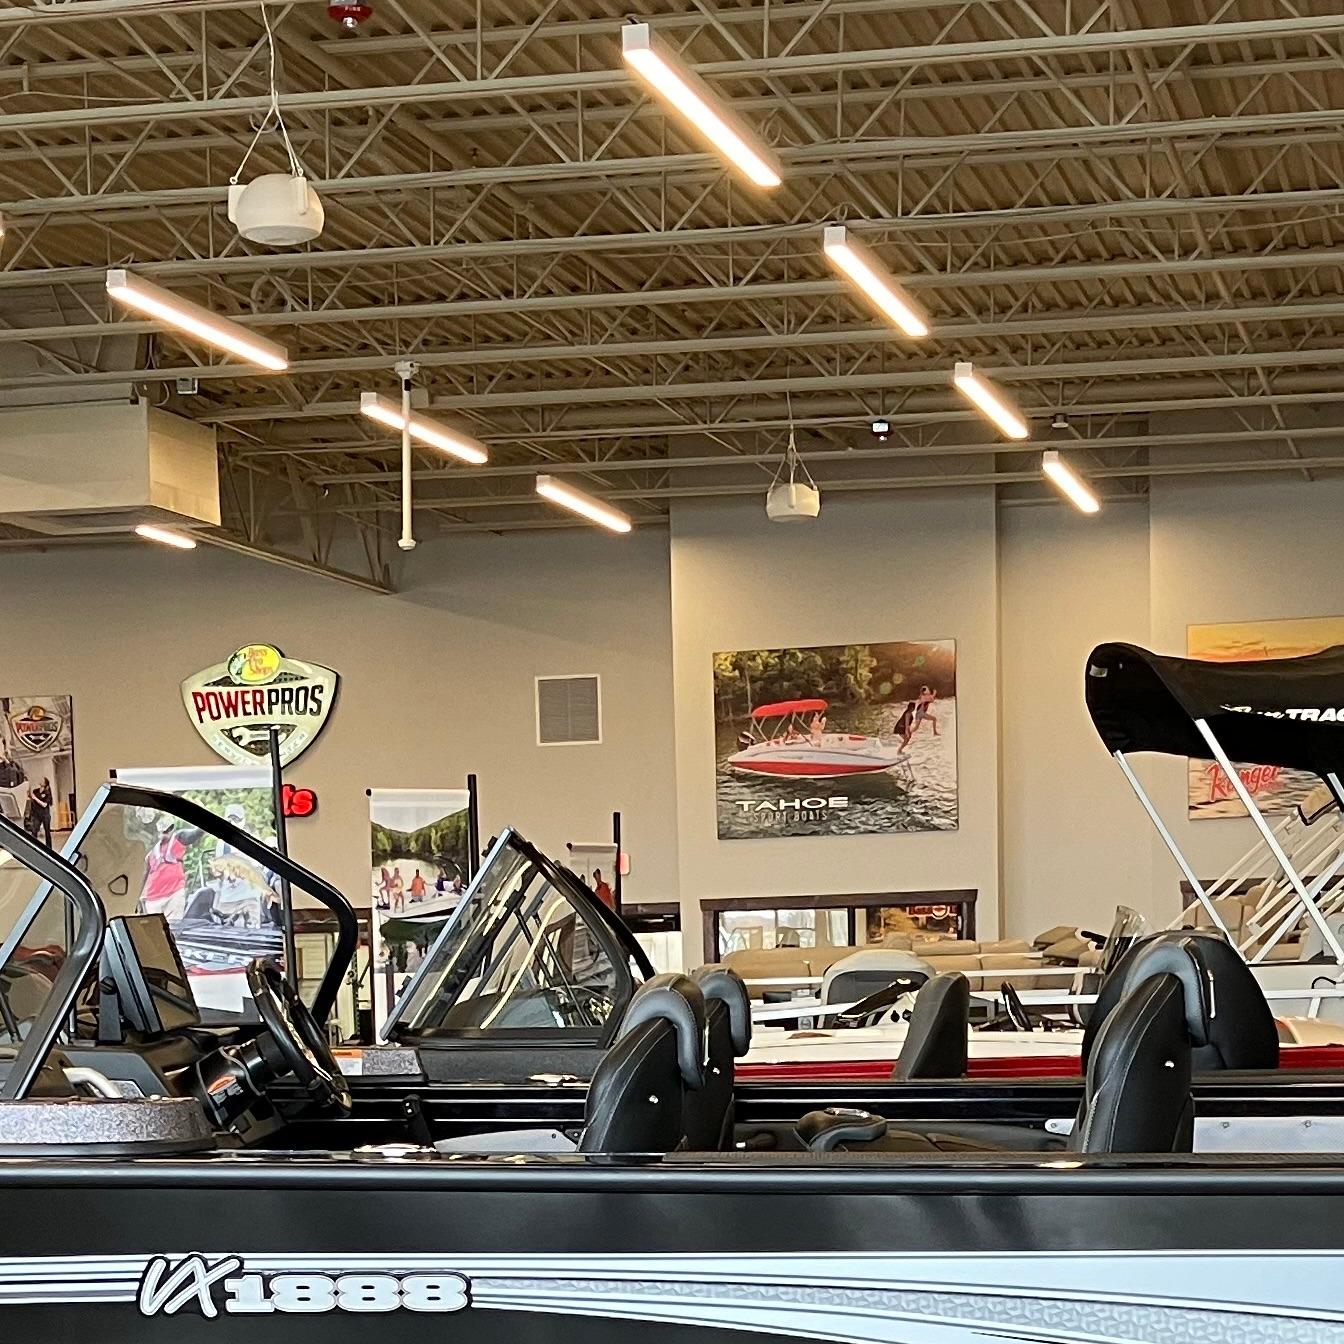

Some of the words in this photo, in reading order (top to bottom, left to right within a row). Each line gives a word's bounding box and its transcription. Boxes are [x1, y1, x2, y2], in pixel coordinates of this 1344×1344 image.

[736, 796, 849, 812] TAHOE
[753, 811, 787, 823] SPORT
[794, 809, 828, 822] BOATS
